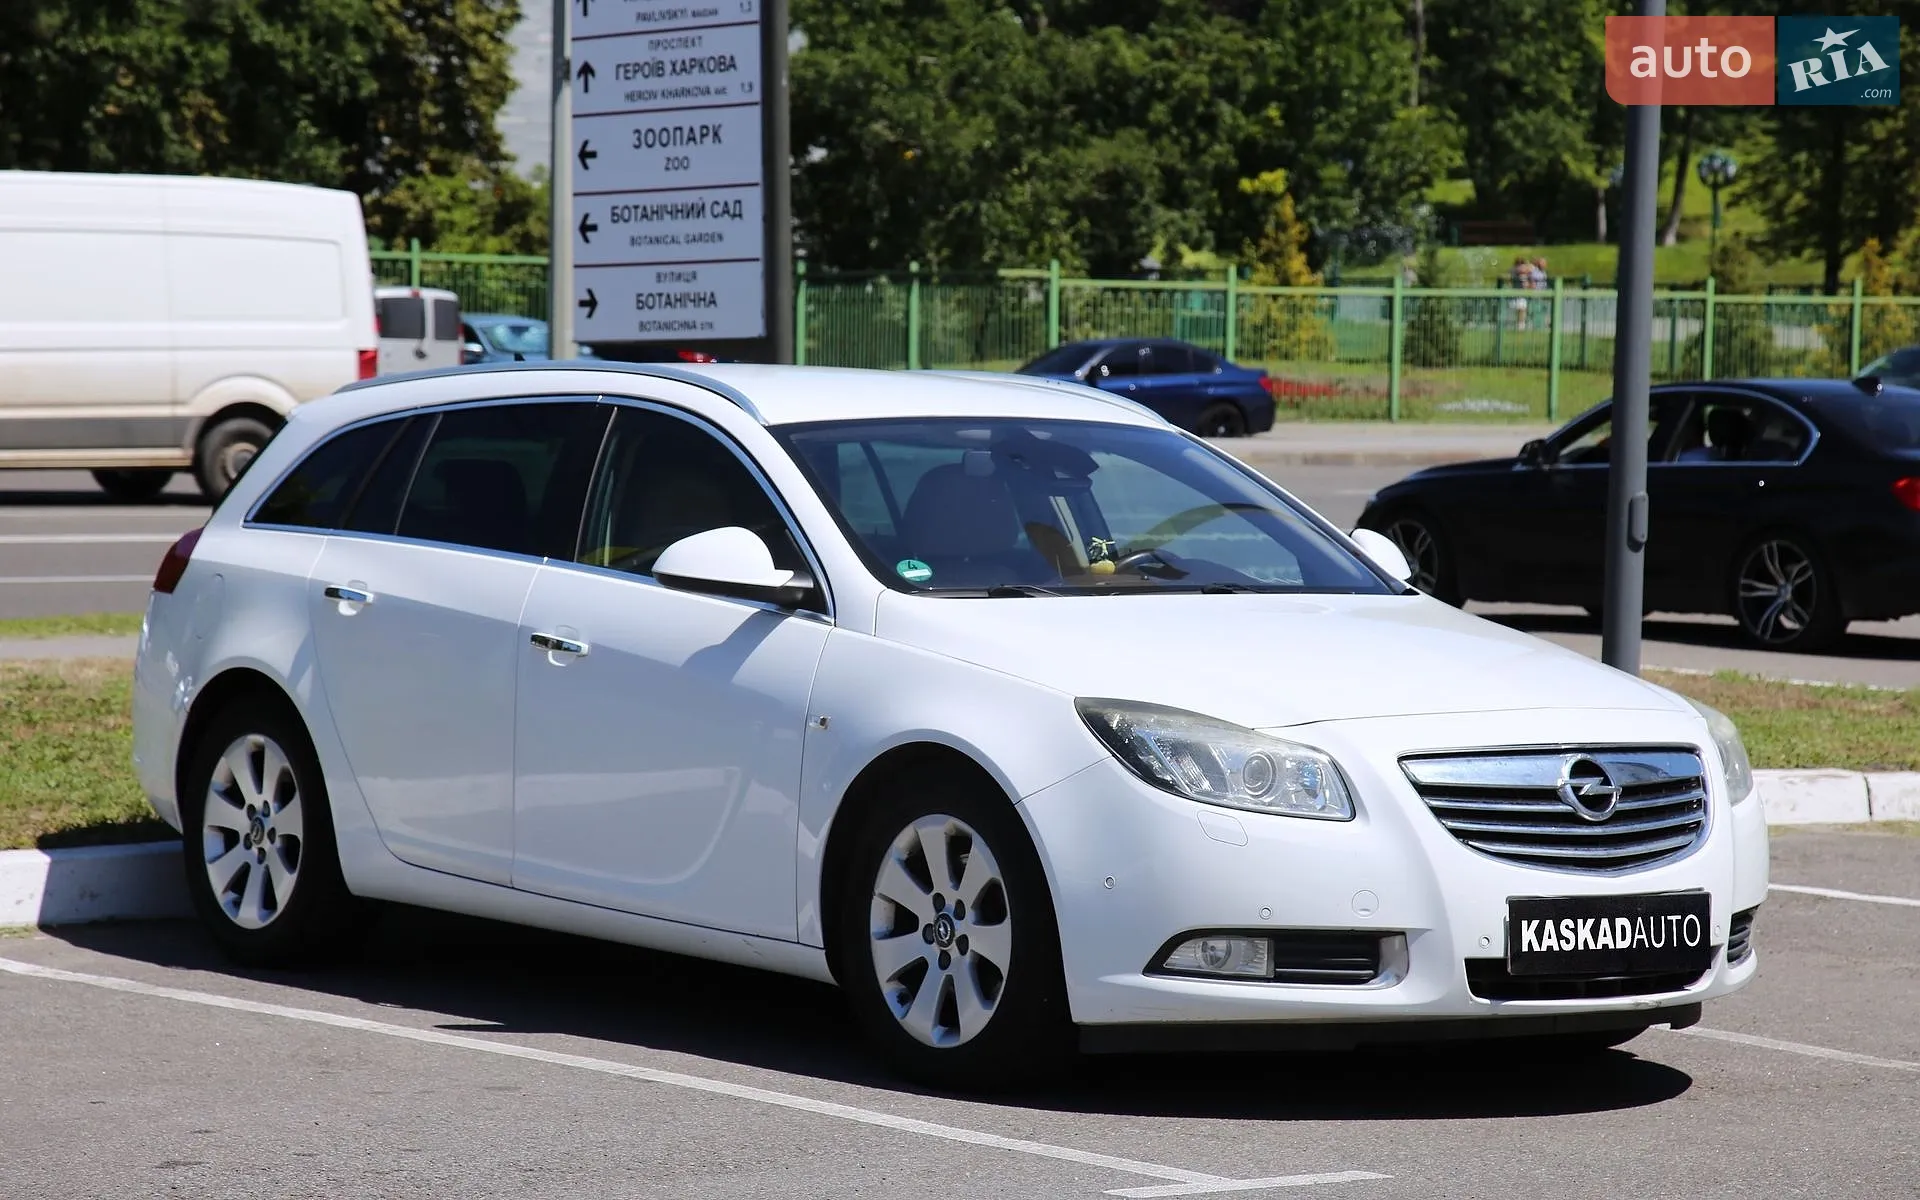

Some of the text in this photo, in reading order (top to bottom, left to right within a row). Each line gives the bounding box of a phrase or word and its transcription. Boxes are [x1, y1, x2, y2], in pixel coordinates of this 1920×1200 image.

[648, 36, 703, 50] ПРОСПЕКТ
[615, 54, 737, 81] ГЕРОЇВ ХАРКОВА
[632, 124, 723, 149] ЗООПАРК
[664, 156, 690, 171] ZOO
[610, 197, 743, 224] БОТАНІЧНИЙ САД
[629, 232, 724, 247] BOTANICAL GARDEN
[656, 271, 698, 284] ВУЛИЦЯ
[636, 291, 717, 311] БОТАНІЧНА
[638, 320, 697, 332] BOTANICHNA
[1521, 914, 1701, 953] KASKADAUTO
